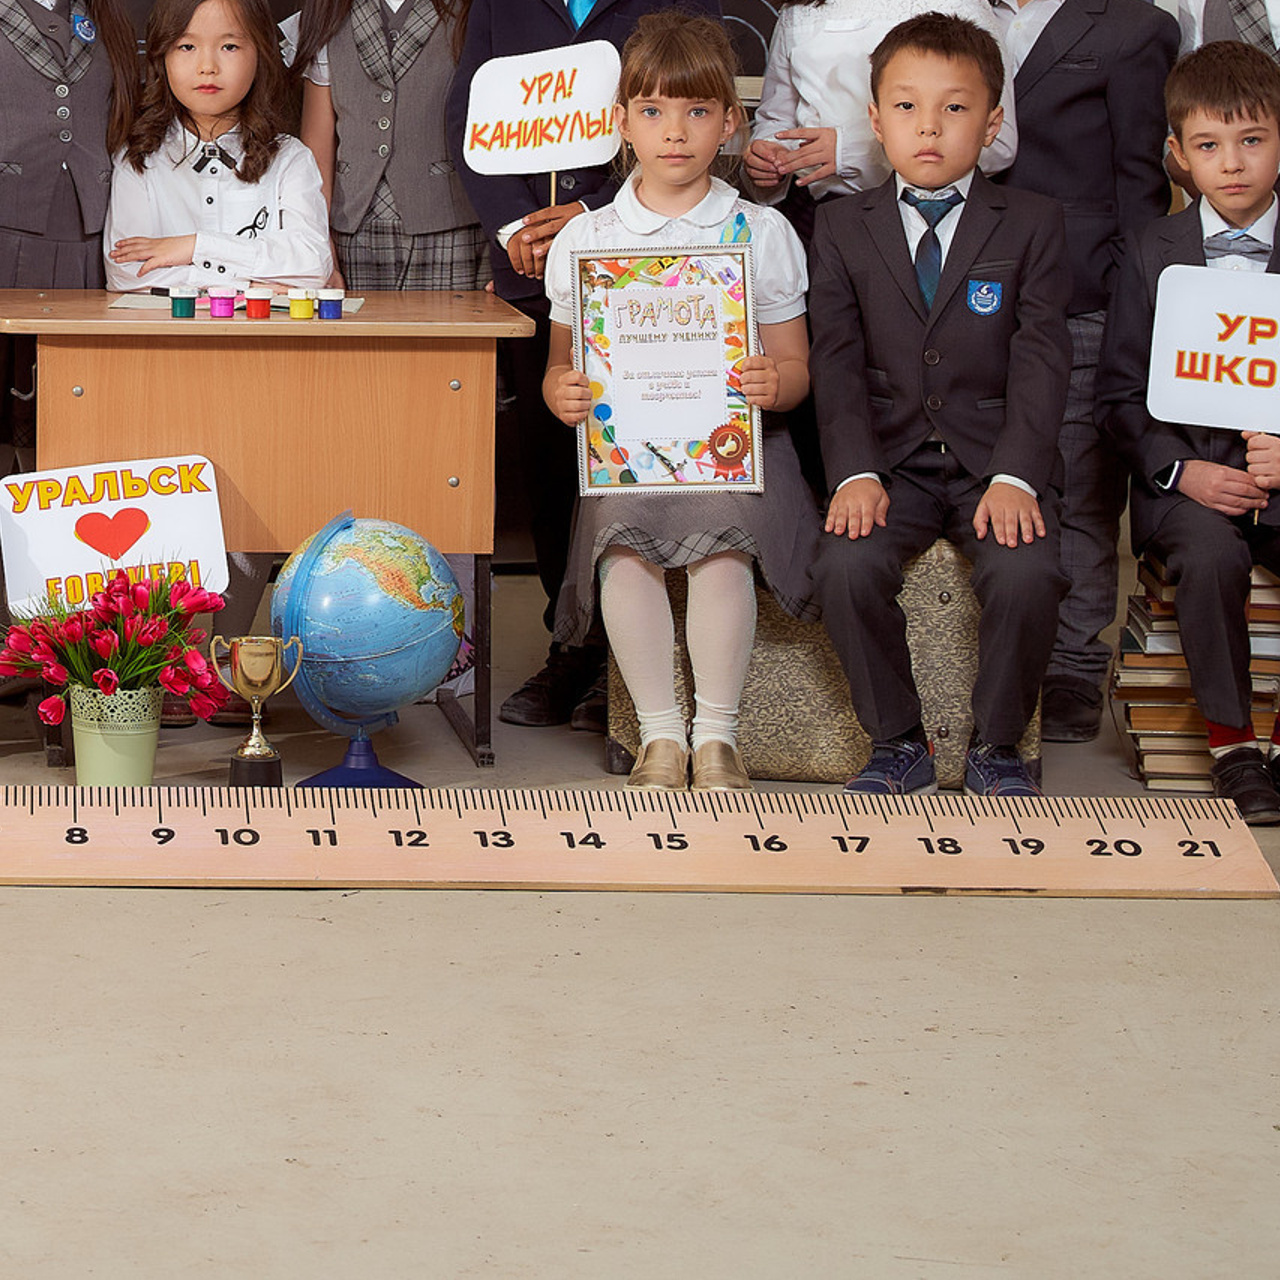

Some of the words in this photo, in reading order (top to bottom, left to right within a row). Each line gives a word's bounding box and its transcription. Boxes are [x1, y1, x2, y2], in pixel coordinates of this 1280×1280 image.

[519, 67, 578, 106] УРА!
[468, 105, 616, 152] КАНИКУЛЫ!
[614, 293, 718, 329] ГРАМОТА
[672, 330, 718, 342] УЧЕНИКУ
[4, 461, 212, 514] УРАЛЬСК
[65, 827, 89, 845] 8
[151, 828, 175, 845] 9
[215, 828, 260, 846] 10
[305, 829, 338, 846] 11
[388, 830, 430, 847] 12
[473, 831, 515, 848] 13
[560, 831, 607, 849] 14
[646, 833, 689, 851] 15
[743, 834, 788, 852] 16
[831, 836, 870, 853] 17
[917, 837, 963, 855] 18
[1002, 838, 1045, 856] 19
[1085, 839, 1142, 857] 20
[1177, 840, 1222, 858] 21
